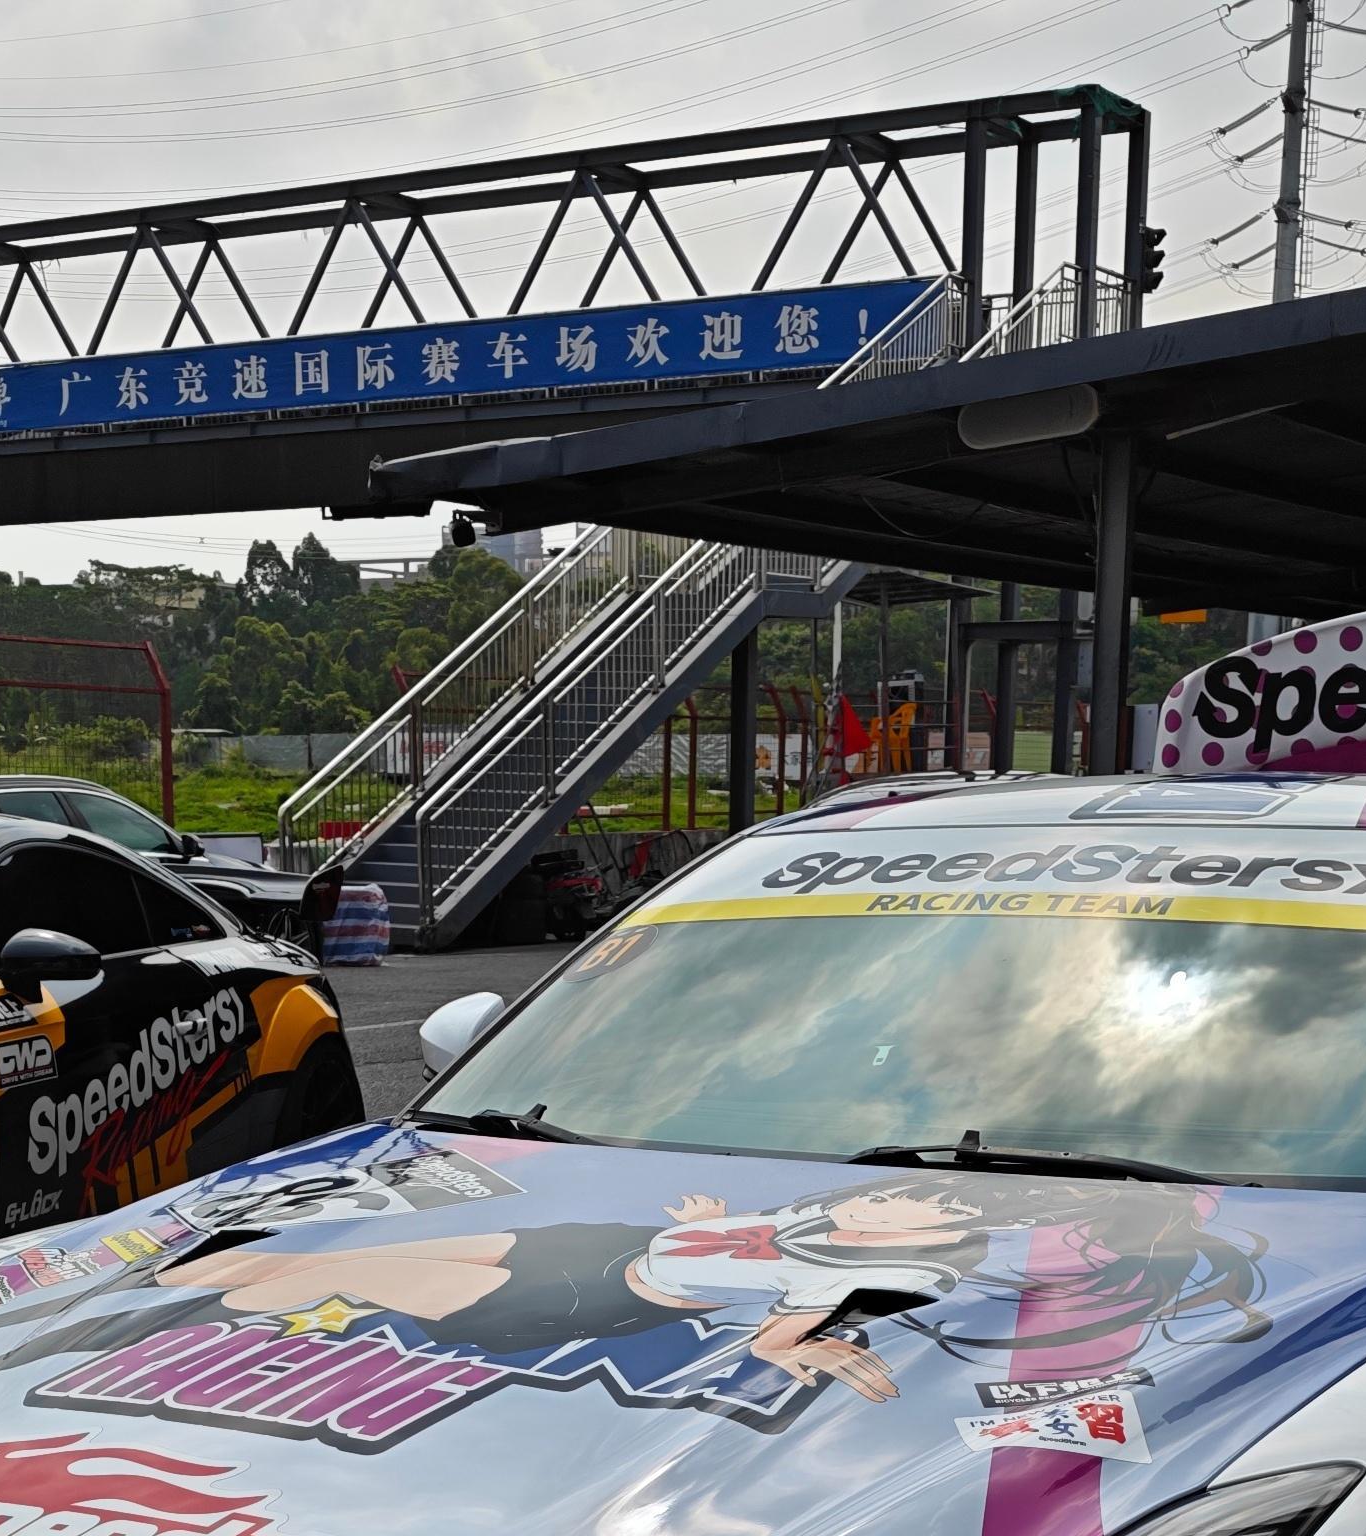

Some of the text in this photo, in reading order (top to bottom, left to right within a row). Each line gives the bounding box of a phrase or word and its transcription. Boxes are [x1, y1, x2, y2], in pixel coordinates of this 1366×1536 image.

[866, 892, 1175, 917] RACING TEAM
[969, 1418, 996, 1429] I'M
